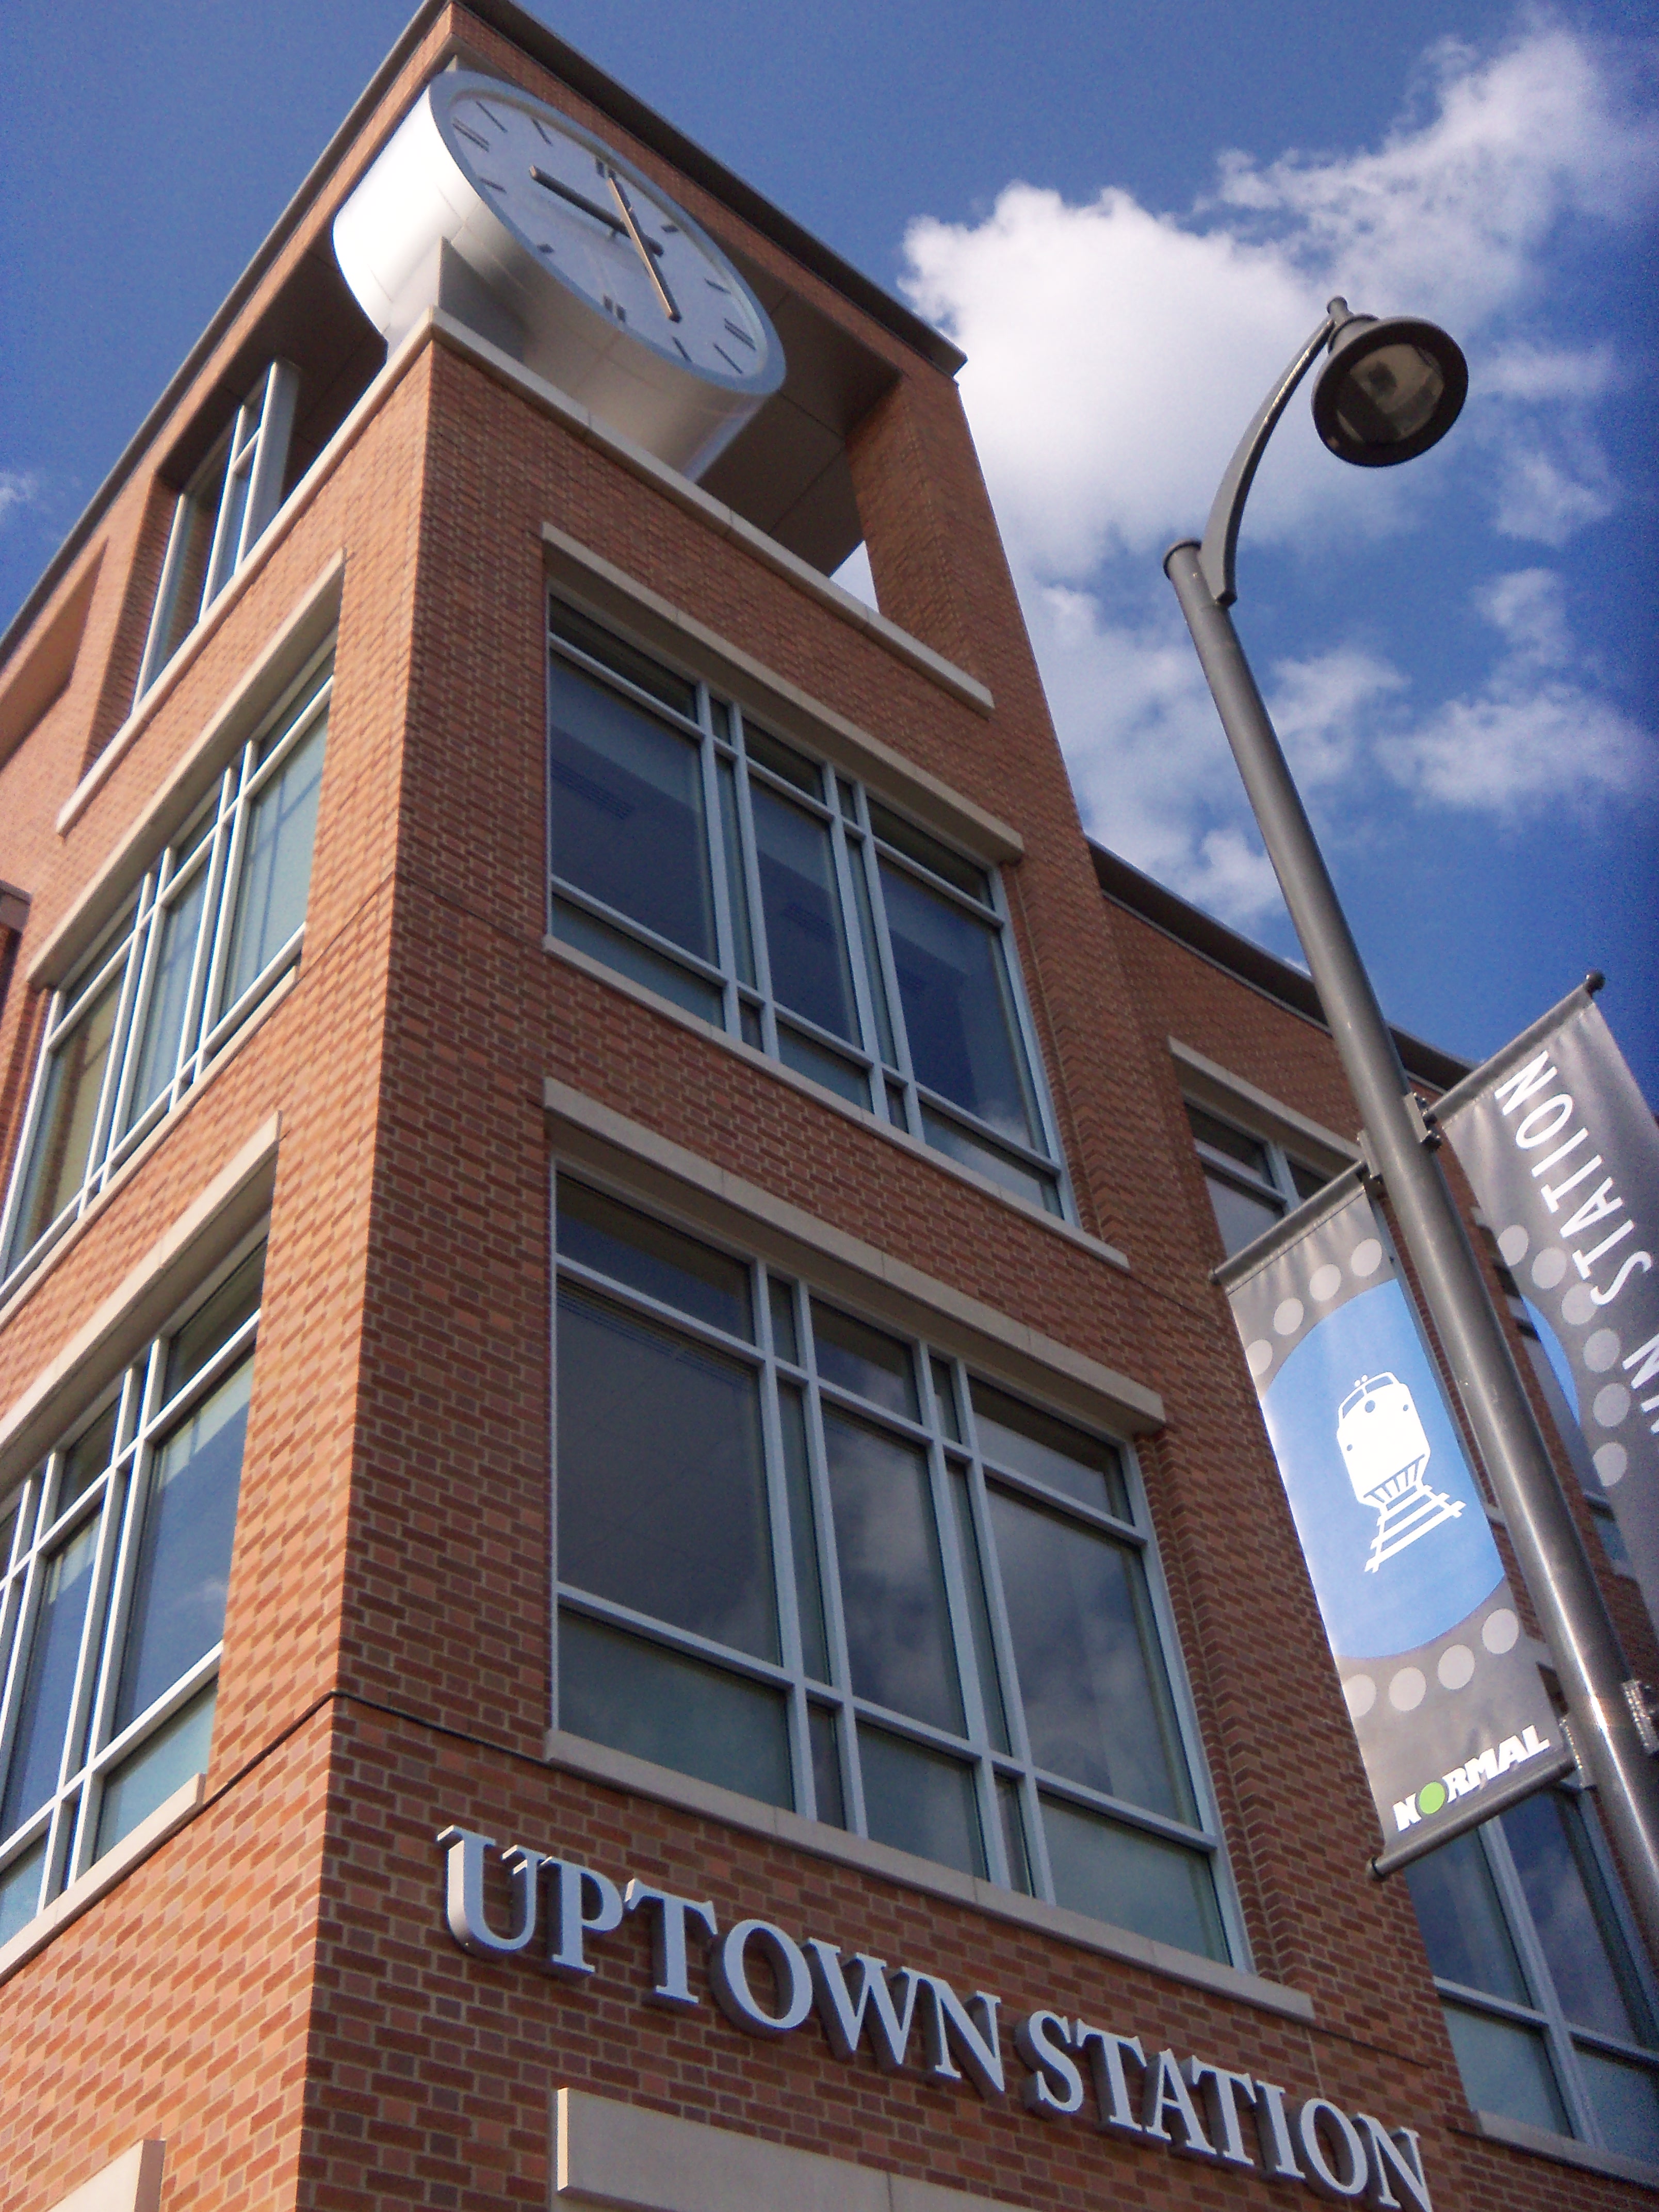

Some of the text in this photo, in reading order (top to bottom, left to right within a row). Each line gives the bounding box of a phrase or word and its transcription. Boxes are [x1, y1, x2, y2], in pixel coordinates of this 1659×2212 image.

[1495, 1050, 1651, 1306] STATION
[437, 1825, 1433, 2212] UPTOWN STATION
